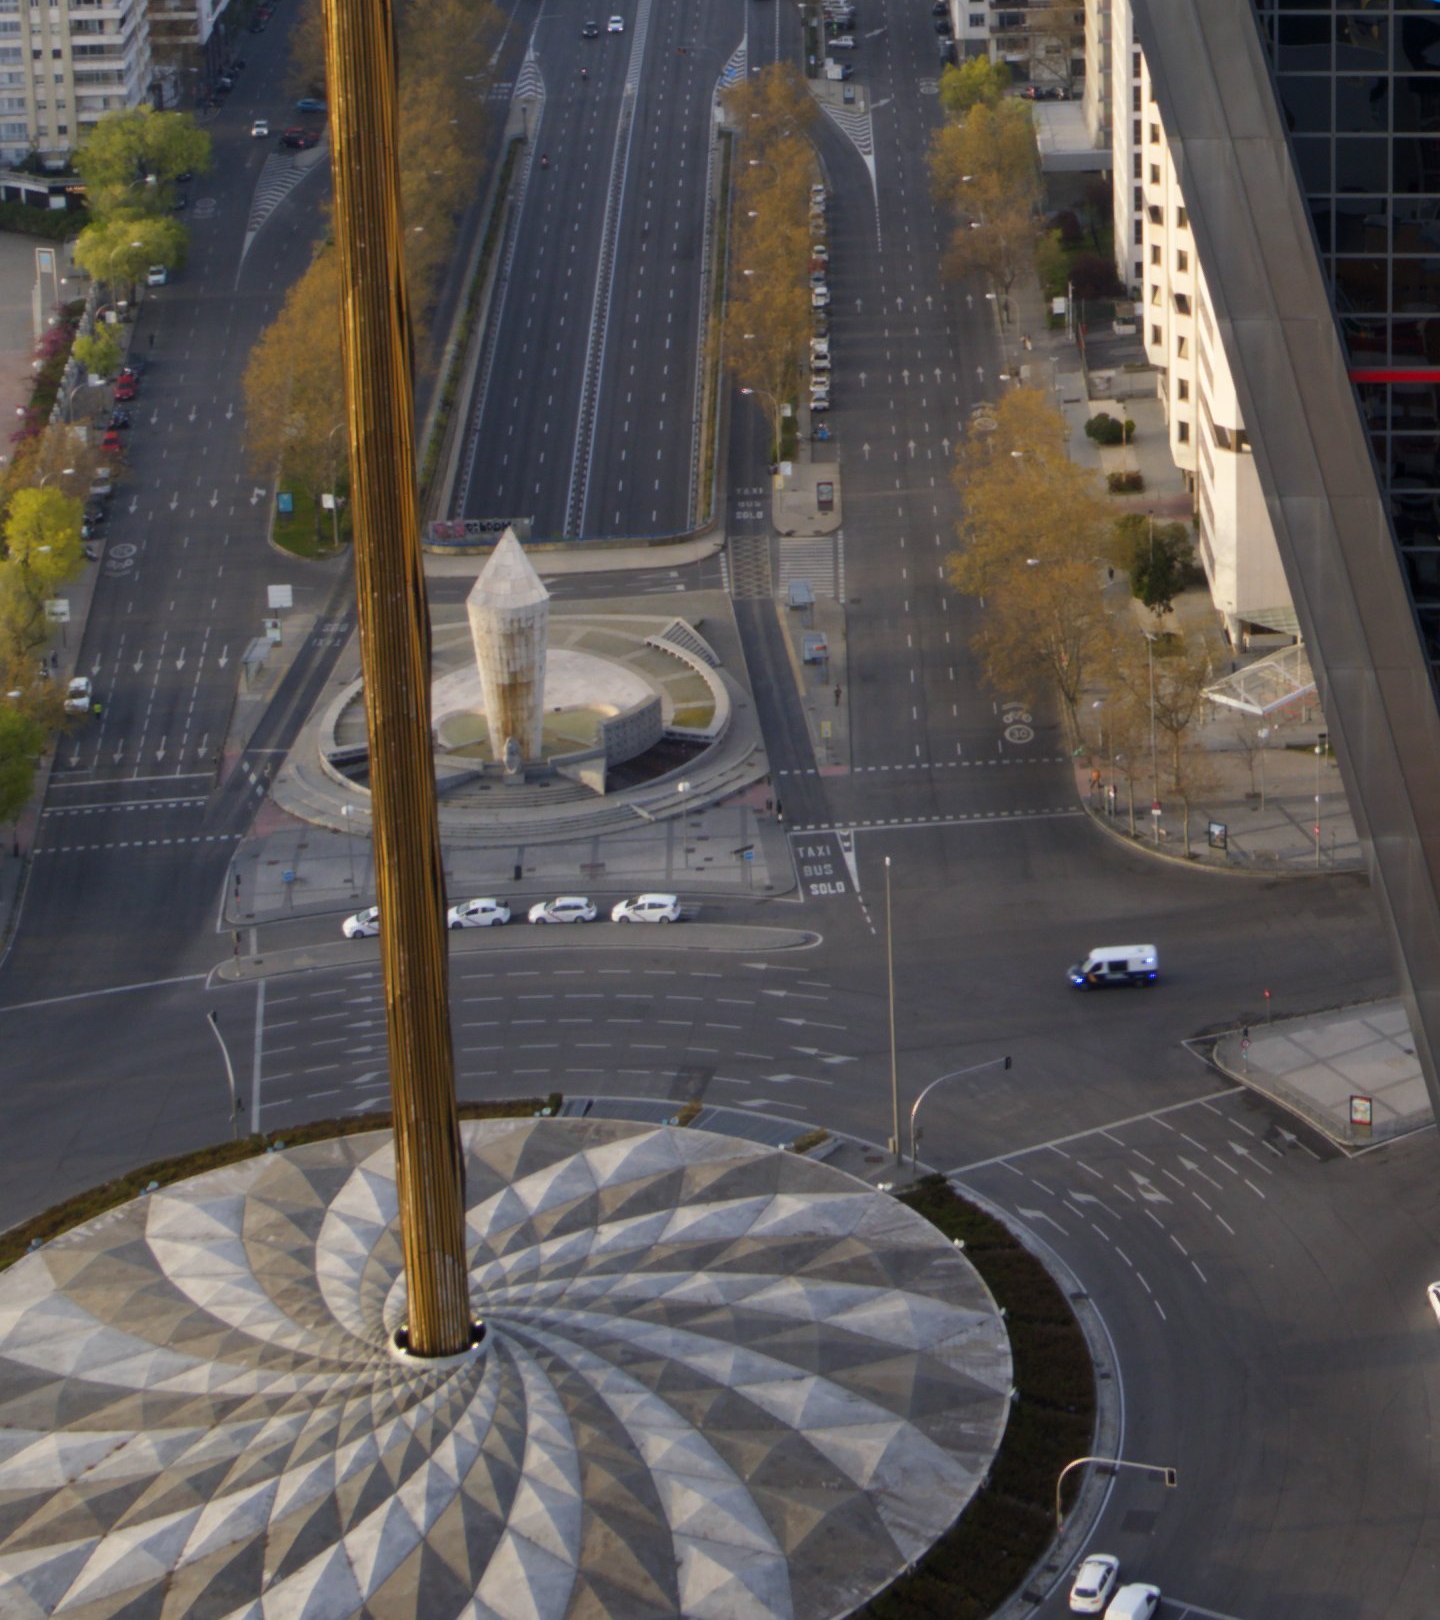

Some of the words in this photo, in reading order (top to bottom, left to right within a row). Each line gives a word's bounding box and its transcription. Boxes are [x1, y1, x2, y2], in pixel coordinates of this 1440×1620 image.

[797, 845, 831, 858] TAXI
[803, 864, 833, 876] BUS
[809, 881, 845, 895] SOLO
